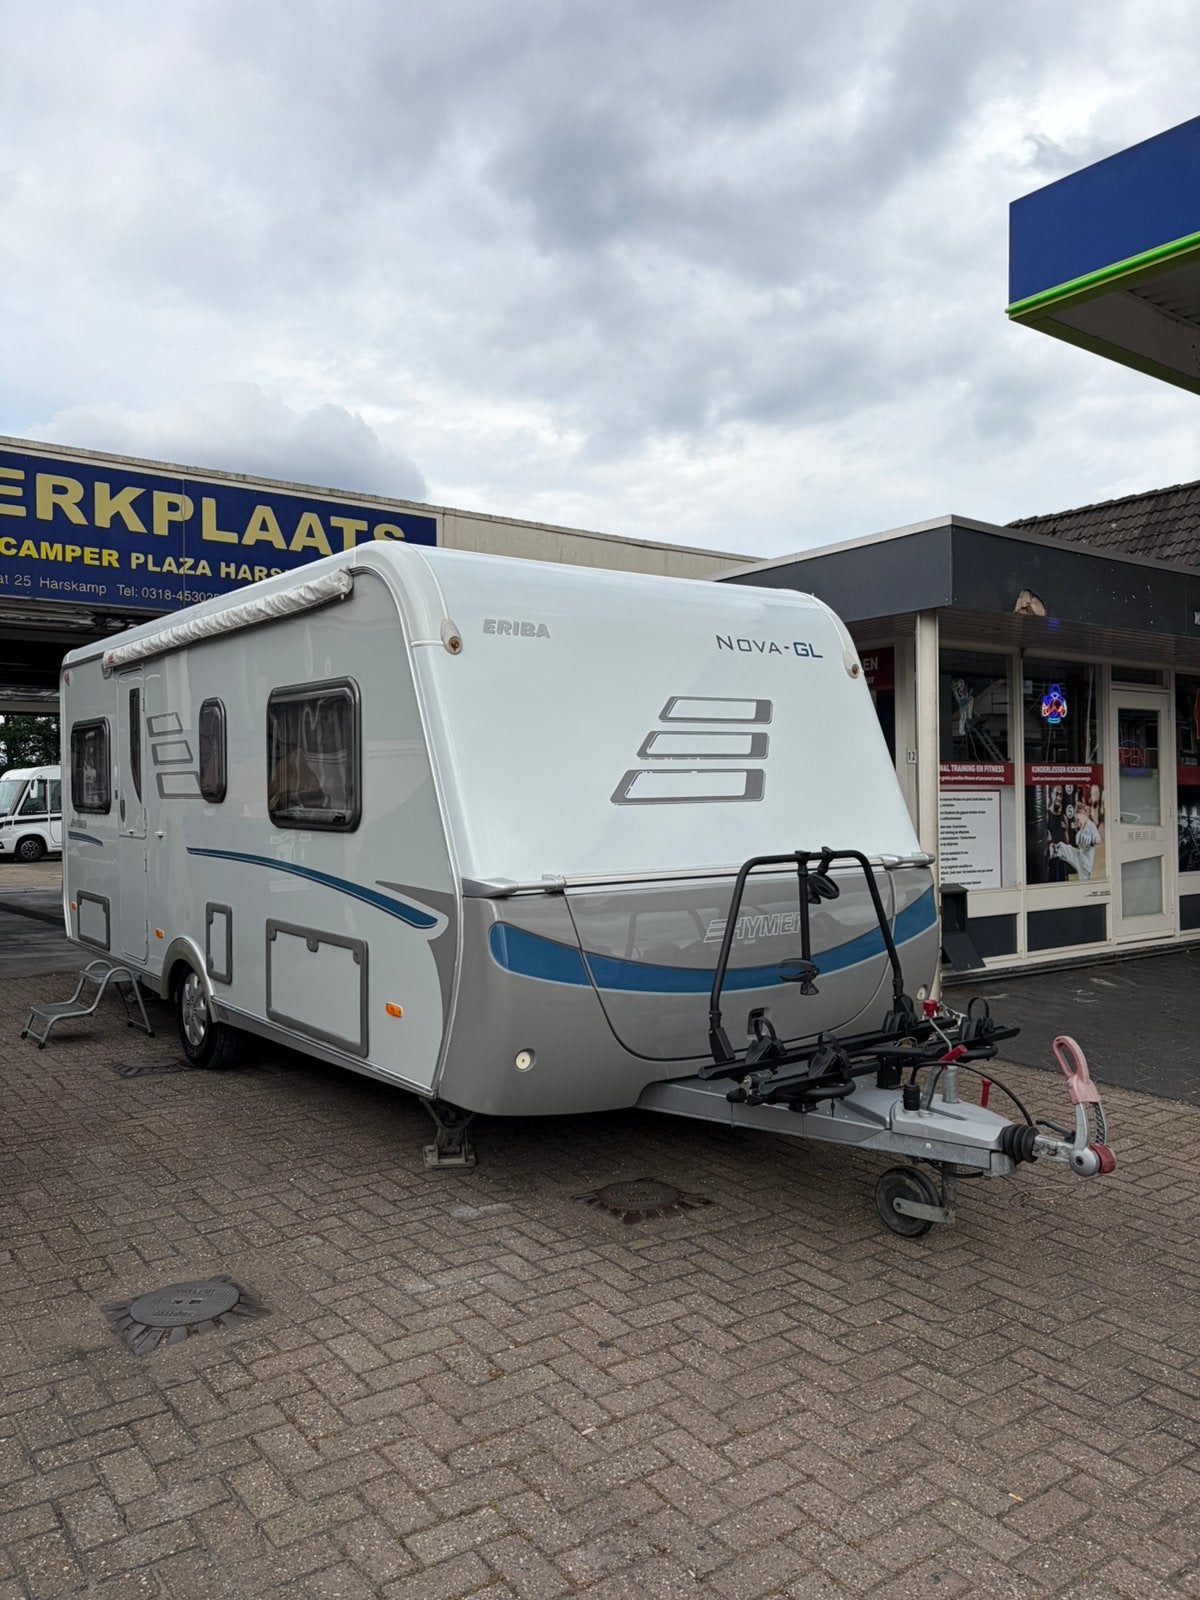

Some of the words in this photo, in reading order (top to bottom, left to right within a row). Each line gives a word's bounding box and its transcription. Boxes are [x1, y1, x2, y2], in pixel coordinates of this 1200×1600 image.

[0, 537, 120, 568] CAMPER
[131, 553, 212, 577] PLAZA
[220, 562, 287, 581] HARS
[14, 574, 32, 587] 25
[39, 577, 107, 595] Harskamp
[117, 584, 138, 598] Tel:
[483, 619, 551, 639] ERIBA
[715, 634, 823, 659] NOVA-GL
[907, 751, 916, 761] 12
[1118, 747, 1146, 768] PEN
[951, 764, 976, 772] TRAINING
[984, 765, 1005, 773] FITNESS
